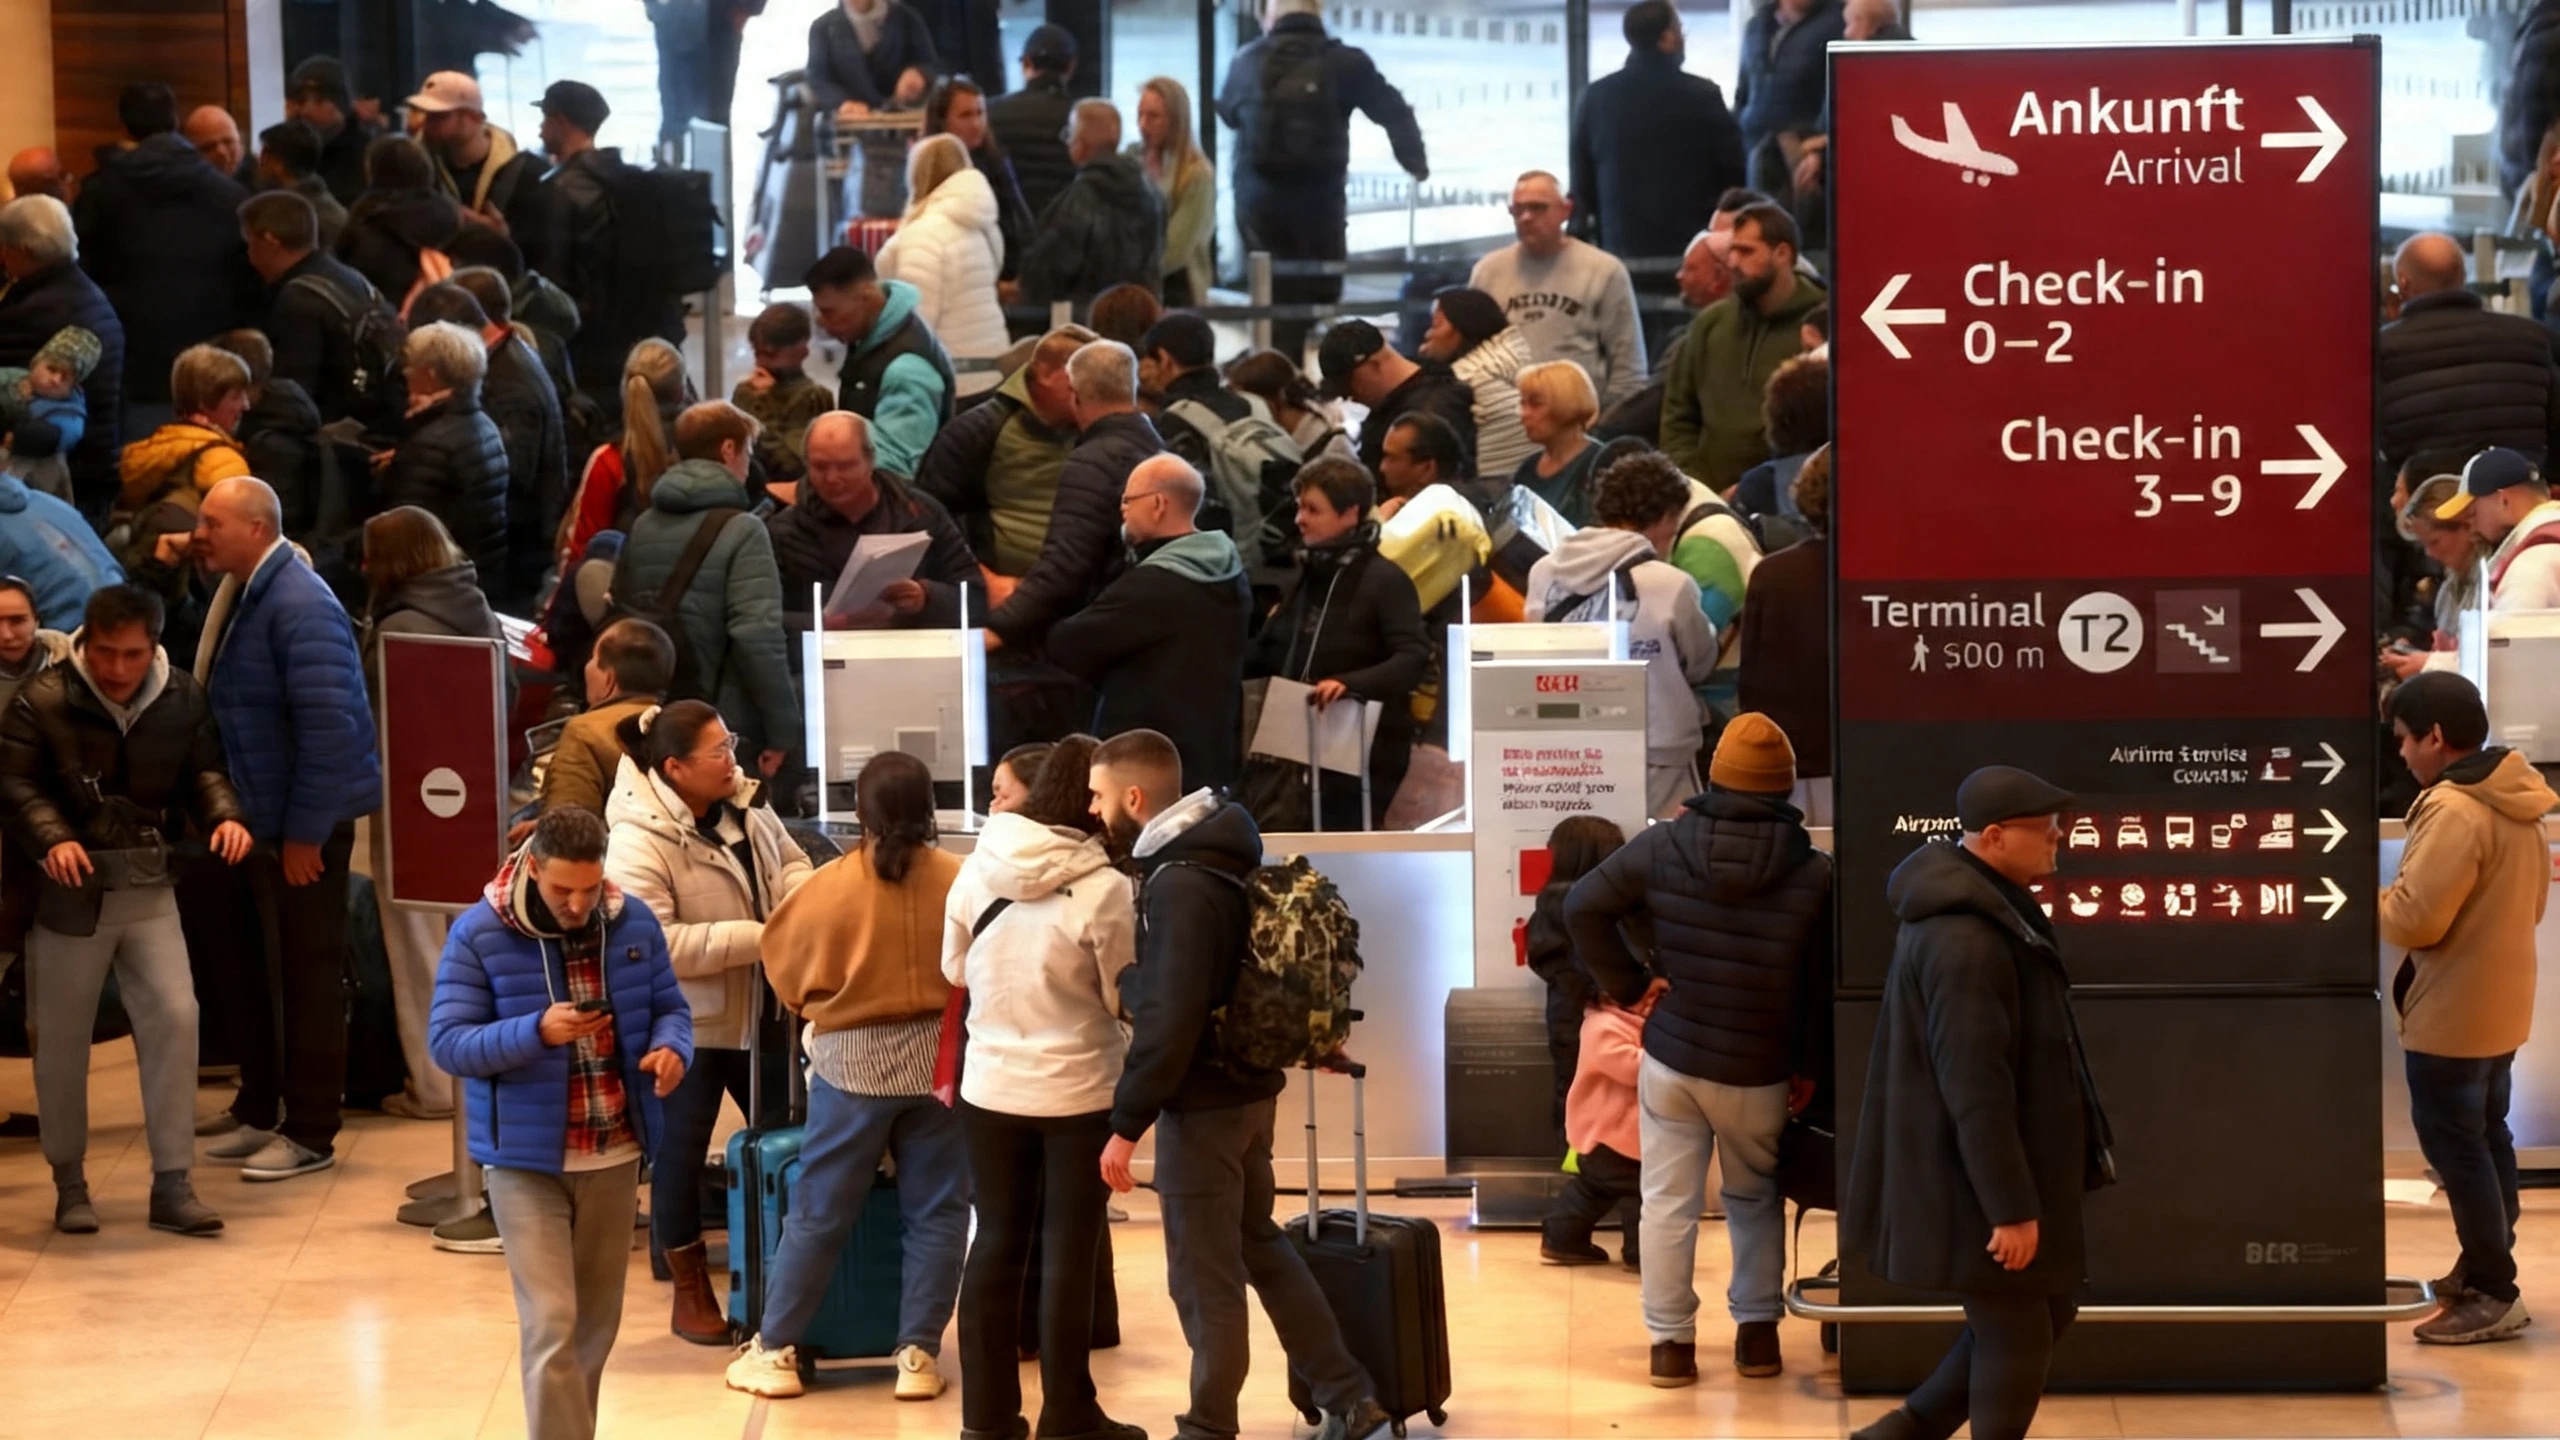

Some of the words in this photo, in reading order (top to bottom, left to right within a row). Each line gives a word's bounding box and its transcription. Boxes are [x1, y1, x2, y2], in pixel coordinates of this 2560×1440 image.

[2009, 83, 2245, 137] Ankunft
[2104, 146, 2244, 186] Arrival
[1963, 257, 2204, 306] Check-in
[2001, 414, 2241, 461] Check-in
[1861, 591, 2046, 628] Terminal
[2070, 613, 2131, 653] T2
[2016, 646, 2044, 669] m
